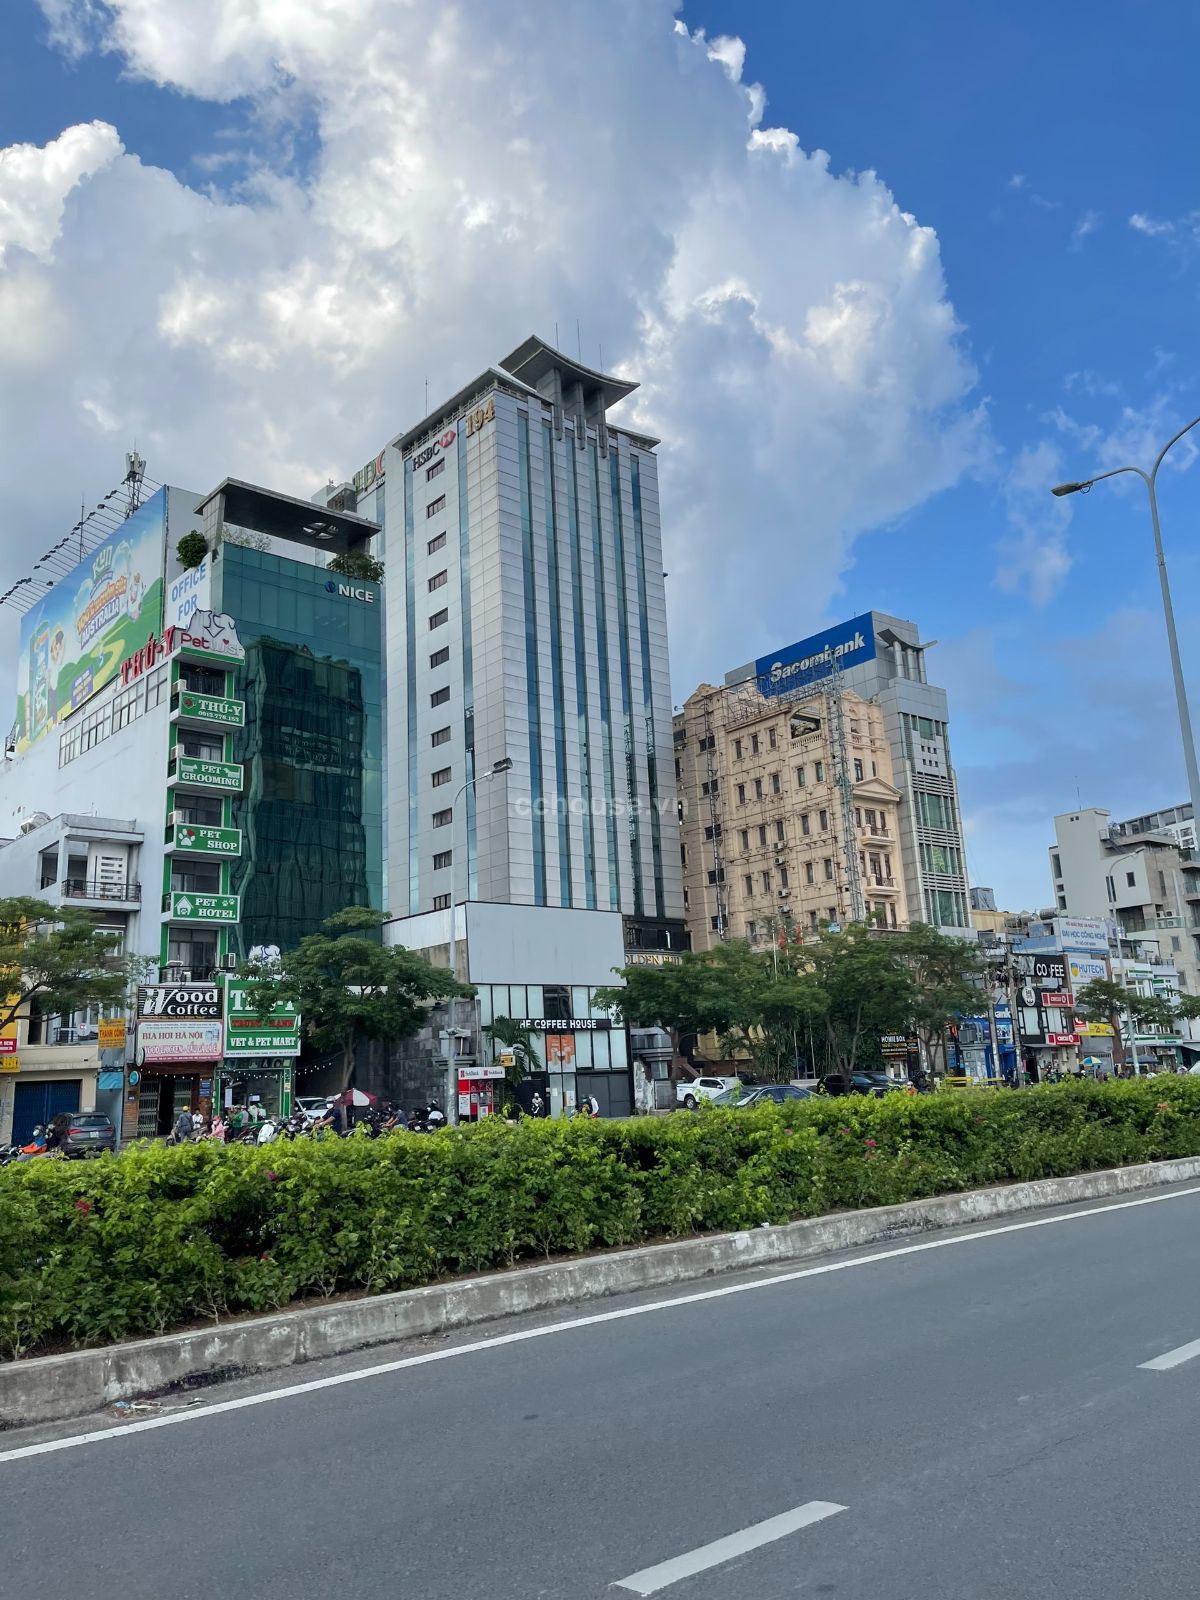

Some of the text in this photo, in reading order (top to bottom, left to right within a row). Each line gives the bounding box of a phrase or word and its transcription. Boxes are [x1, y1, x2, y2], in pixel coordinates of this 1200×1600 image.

[467, 400, 496, 438] 194
[412, 441, 441, 472] HSBC
[172, 563, 206, 602] OFFICE
[338, 584, 374, 603] NICE
[178, 594, 198, 621] FOR
[771, 631, 866, 683] Sacombank
[198, 699, 242, 716] THÚ-Y
[201, 764, 222, 774] PET
[182, 771, 239, 786] GROOMING
[199, 829, 221, 839] PET
[207, 840, 238, 850] SHOP
[195, 897, 217, 907] PET
[198, 908, 236, 918] HOTEL
[624, 954, 660, 965] OLDEN
[1036, 963, 1065, 977] COFEE
[1079, 963, 1105, 975] HUTECH
[143, 988, 218, 1015] Wood
[167, 1004, 218, 1015] Coffee
[520, 1020, 597, 1029] HE COFFEE HOUSE
[230, 1036, 296, 1047] VET & PET MART
